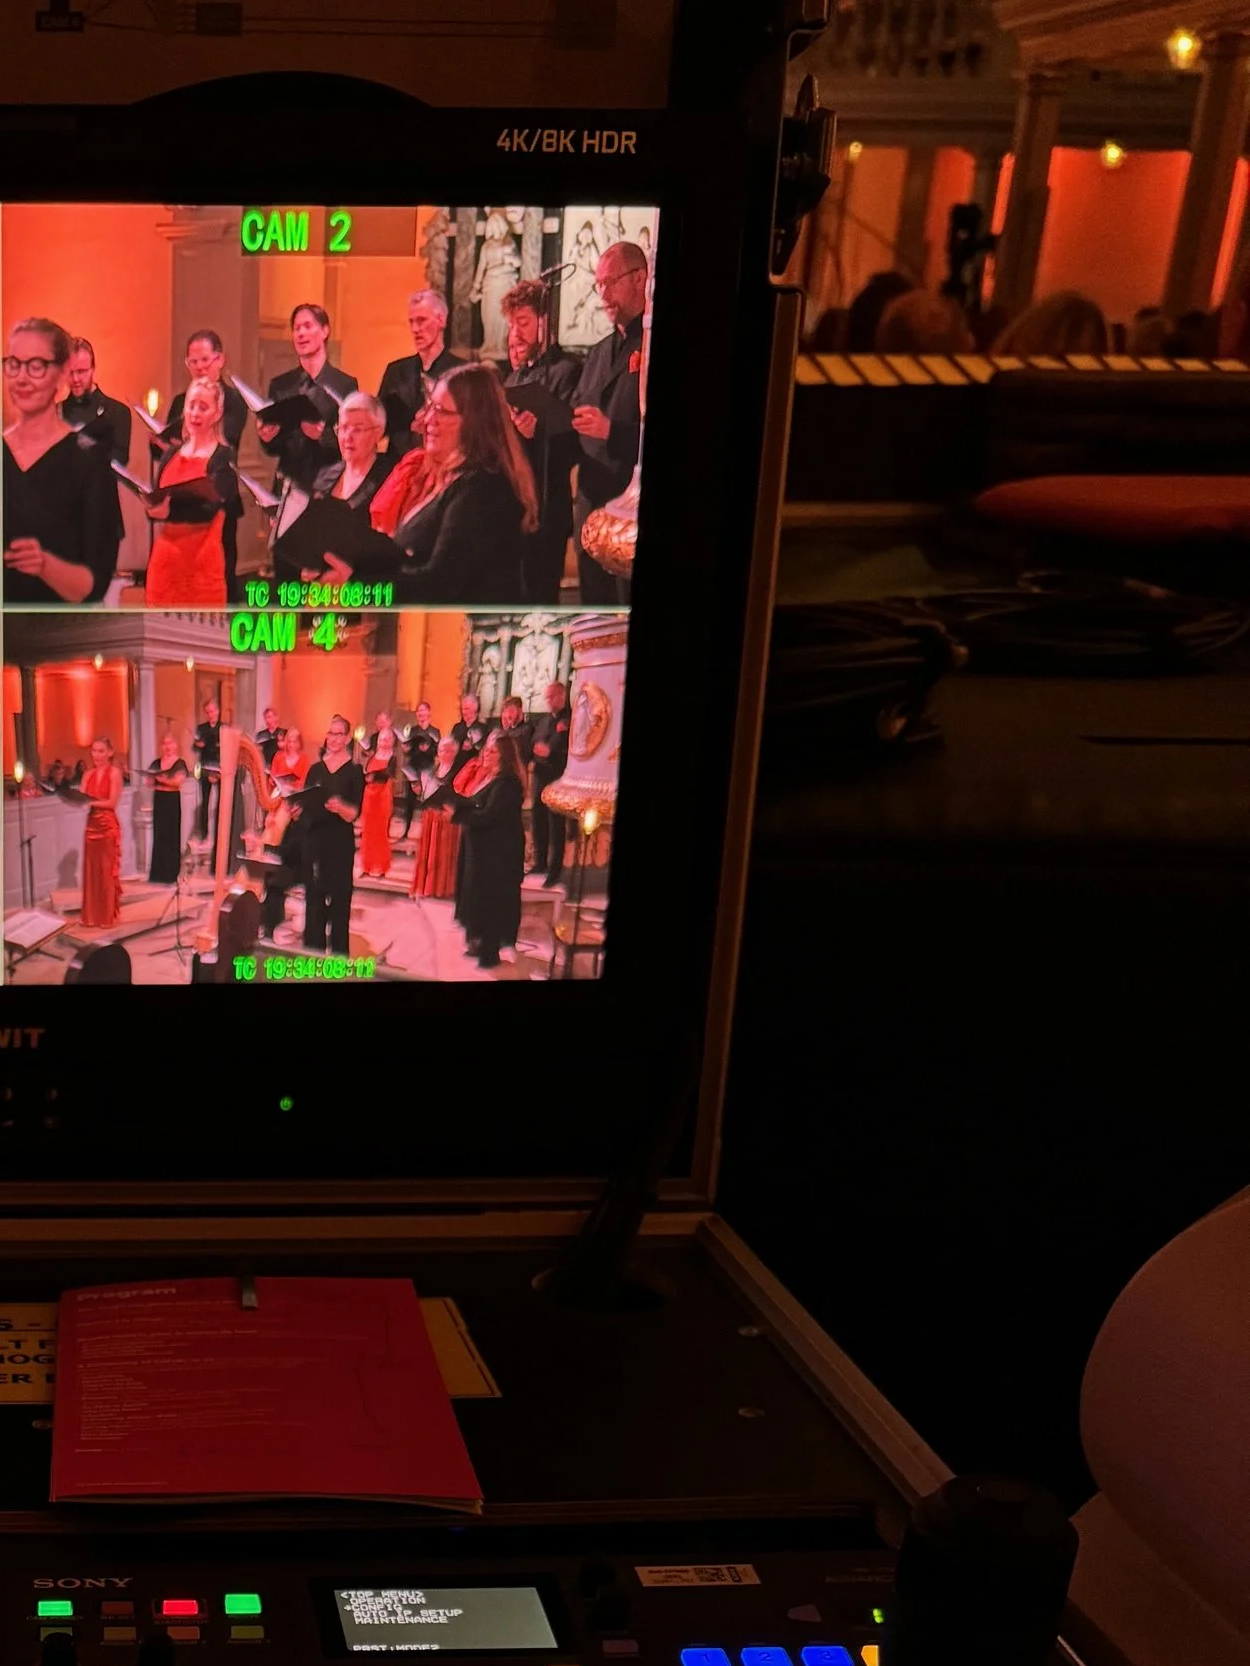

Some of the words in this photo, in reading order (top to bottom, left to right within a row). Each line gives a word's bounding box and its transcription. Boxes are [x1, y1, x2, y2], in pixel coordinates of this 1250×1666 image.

[497, 129, 576, 152] 4K/8K
[582, 130, 636, 154] HDR
[242, 210, 309, 251] CAM
[329, 210, 351, 251] 2
[246, 581, 269, 607] TC
[231, 612, 296, 651] CAM
[313, 613, 337, 650] 4
[233, 956, 257, 980] TC
[33, 1577, 134, 1588] SONY
[350, 1597, 426, 1605] OPERATION
[420, 1608, 464, 1617] SETUP
